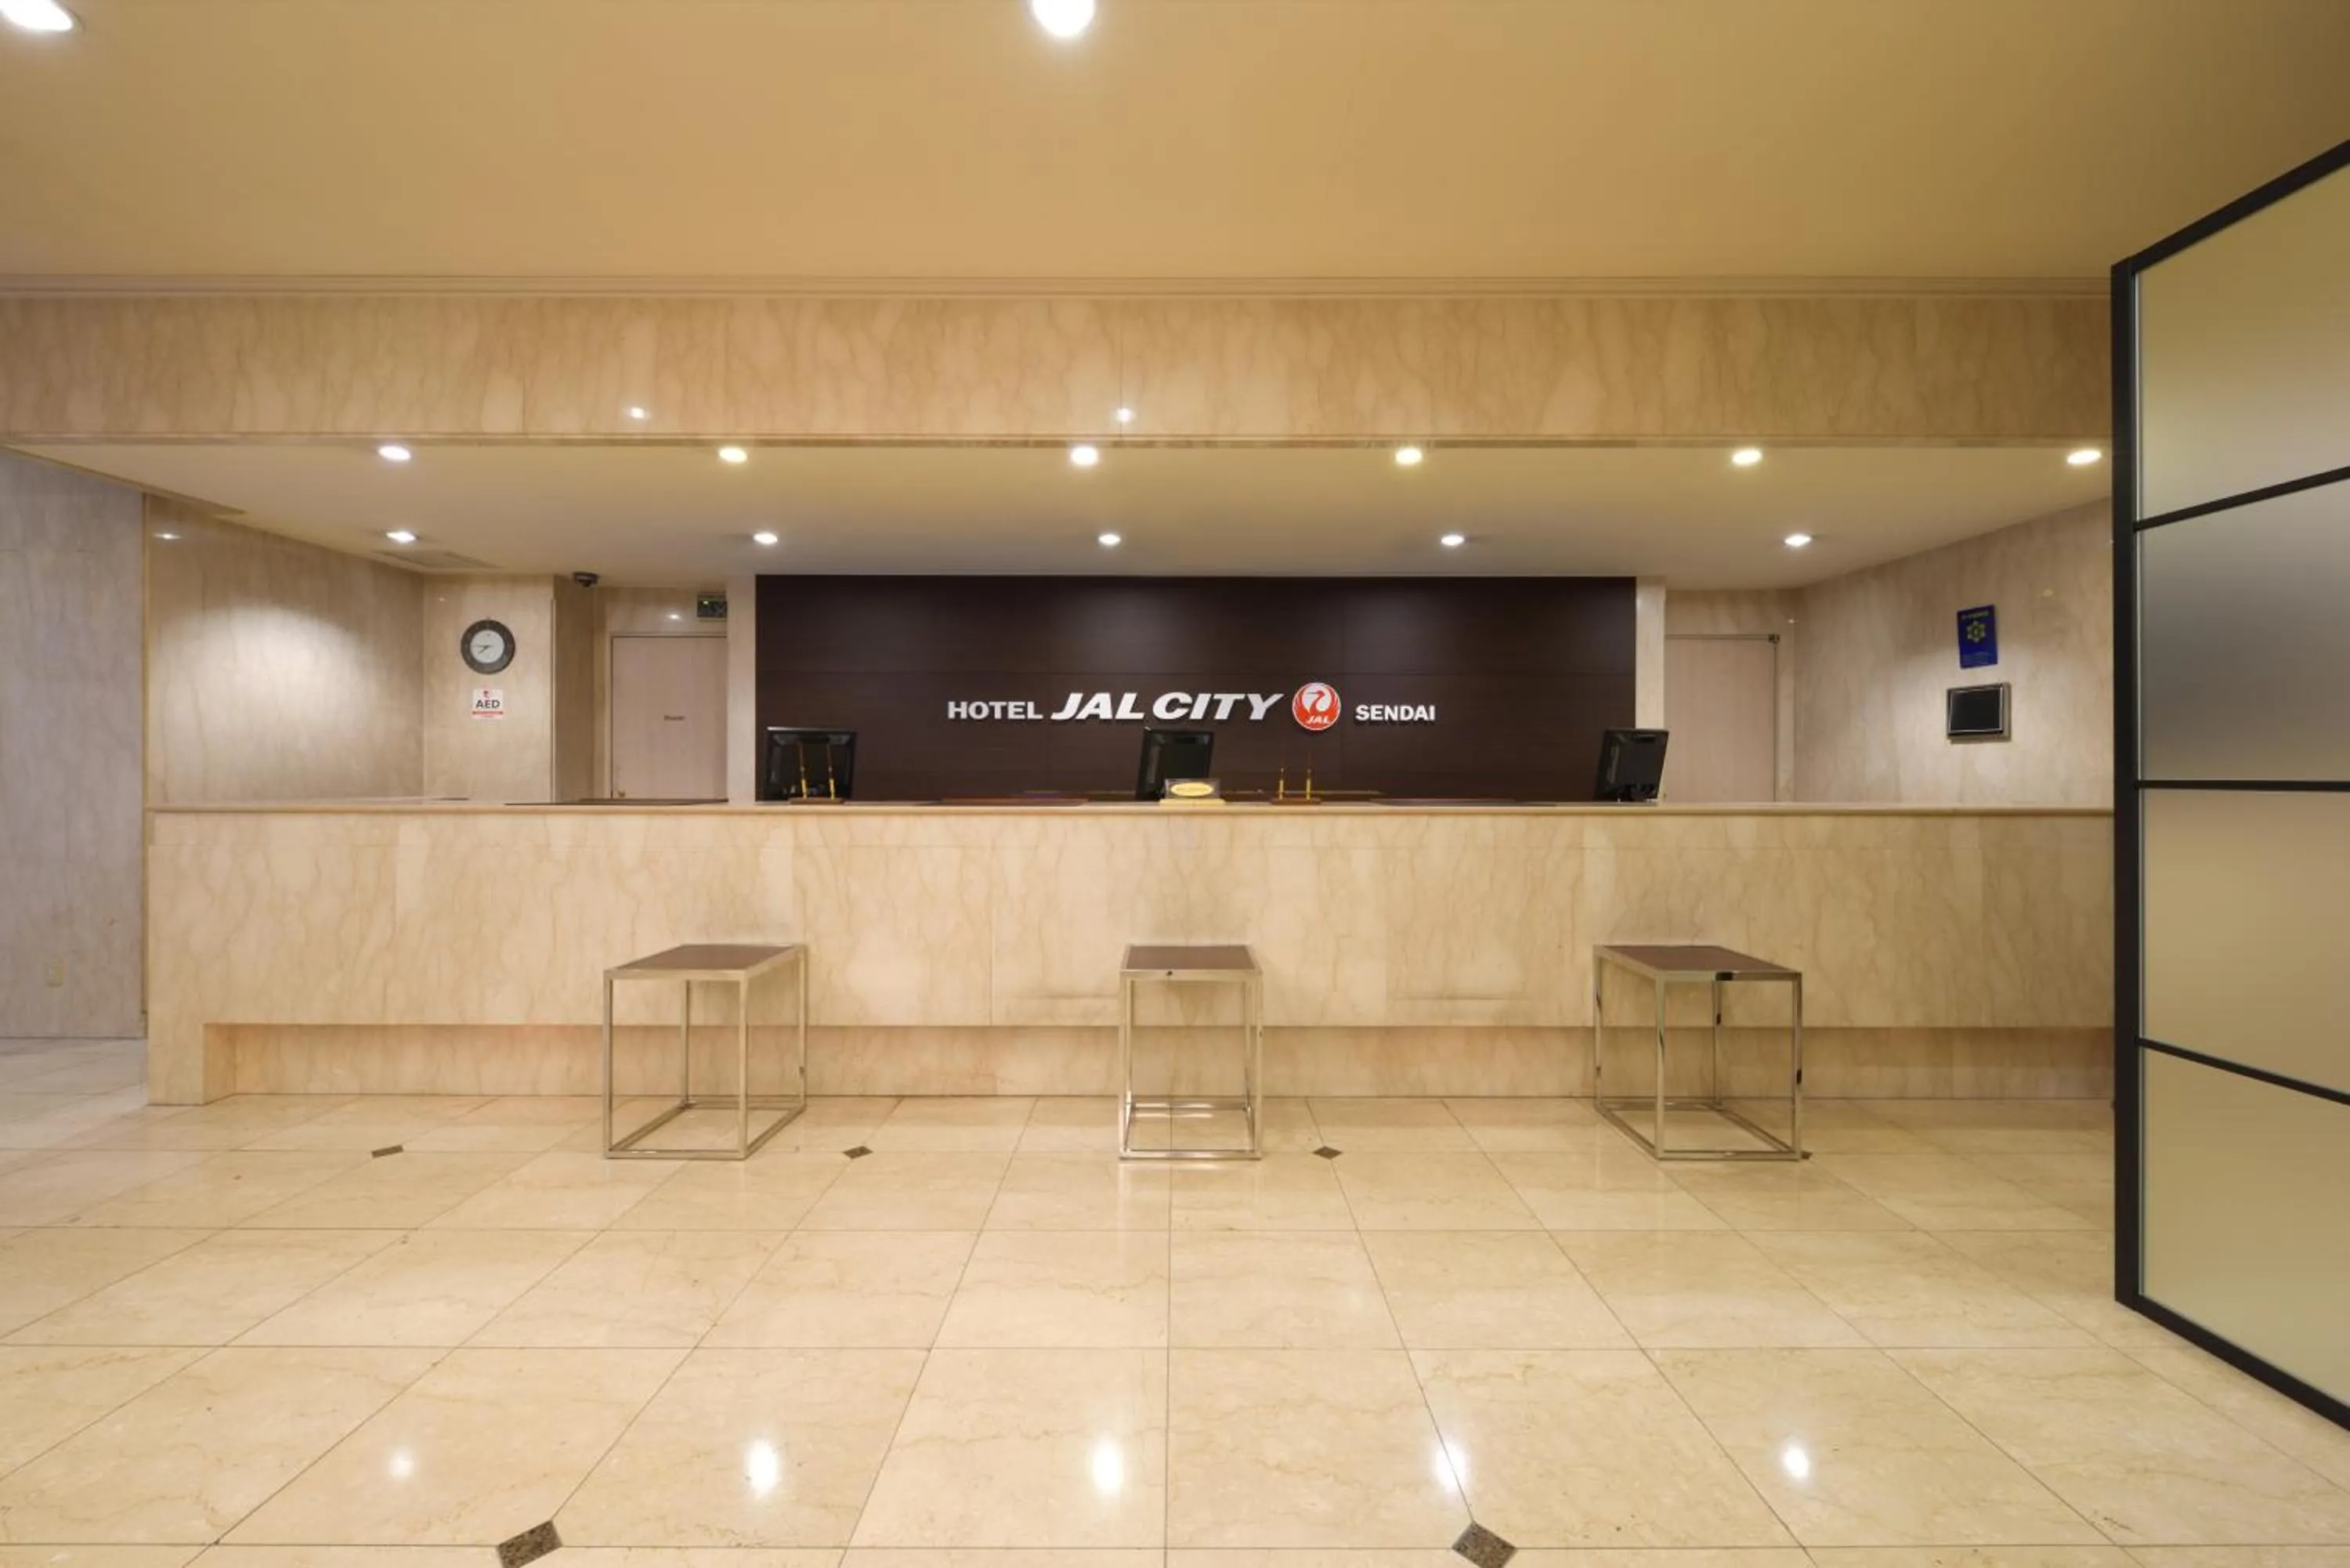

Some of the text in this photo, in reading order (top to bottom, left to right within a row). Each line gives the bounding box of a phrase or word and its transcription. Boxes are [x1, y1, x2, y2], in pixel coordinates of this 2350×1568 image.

[475, 699, 501, 709] AED
[947, 692, 1436, 721] HOTEL JAL CITY SENDAI
[1306, 715, 1330, 724] JAL
